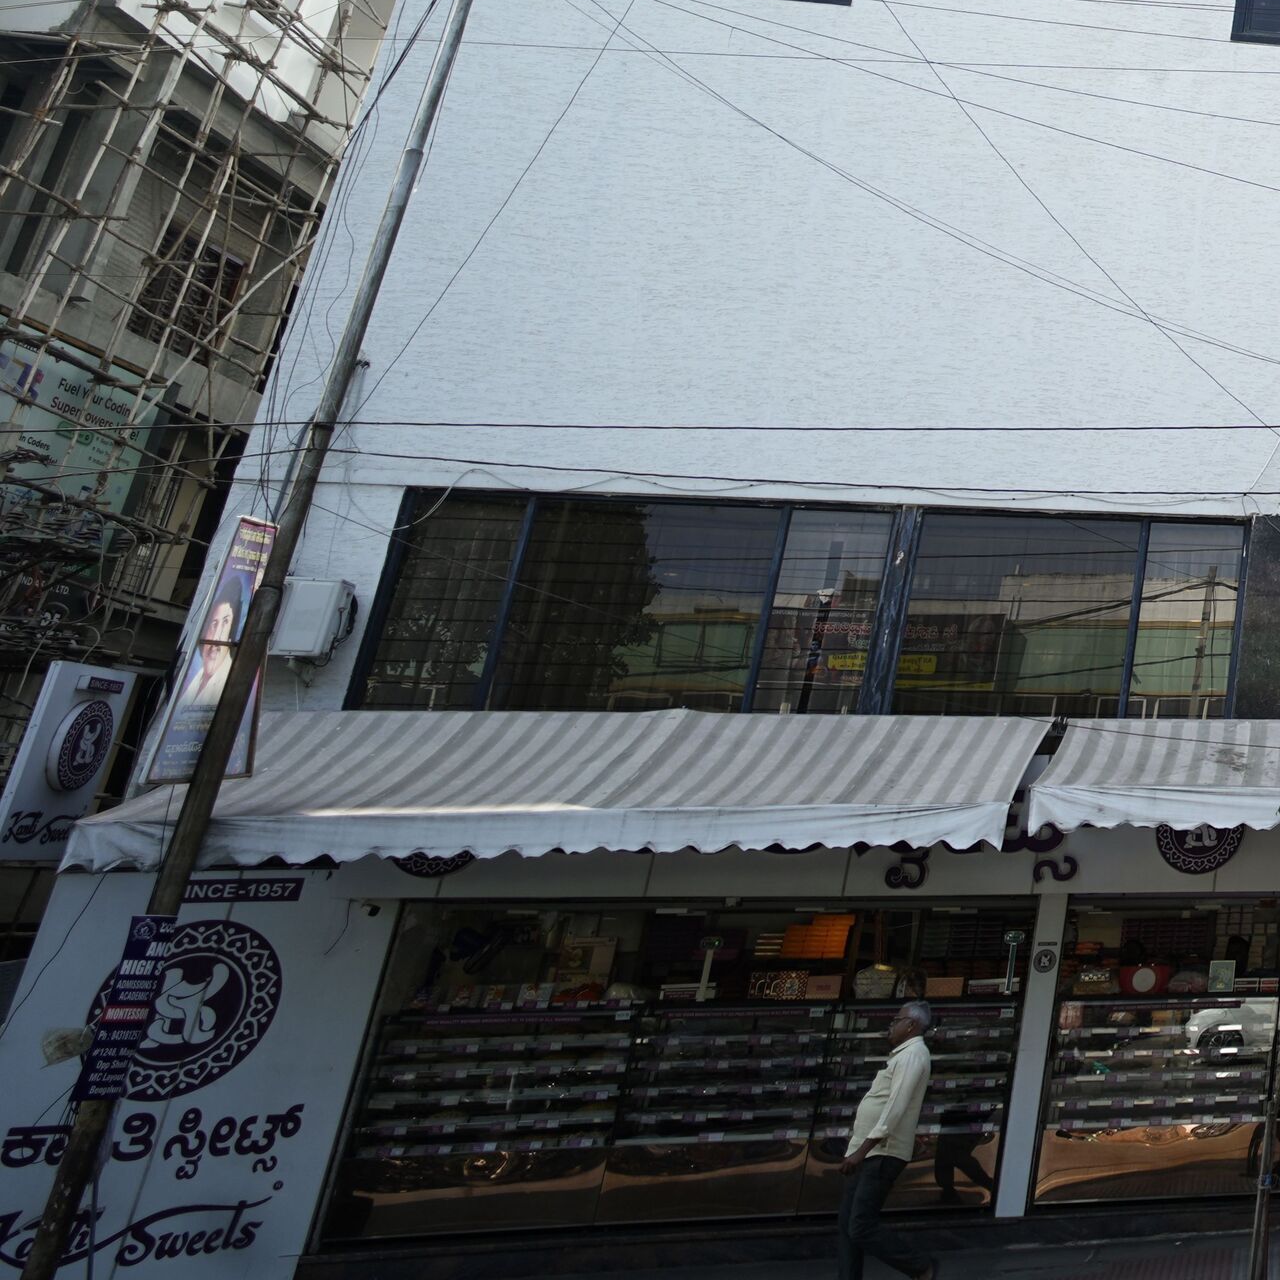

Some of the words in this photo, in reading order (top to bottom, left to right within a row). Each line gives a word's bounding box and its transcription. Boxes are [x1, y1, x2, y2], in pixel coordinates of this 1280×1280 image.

[58, 378, 80, 397] Fuel
[81, 387, 103, 405] Yur
[104, 398, 131, 417] Codin
[184, 882, 297, 899] INCE-1957
[120, 959, 152, 975] HIGH
[117, 980, 151, 990] ADMISSIONS
[118, 991, 148, 1001] ACADEMIC
[106, 1007, 149, 1020] MONTESSOR
[96, 1060, 109, 1071] Opp
[89, 1073, 101, 1082] MC
[1, 1112, 157, 1168] ಕಾತಿ
[164, 1104, 304, 1180] ಸ್ವೀಟ್ಸ್
[115, 1196, 272, 1266] Sweets
